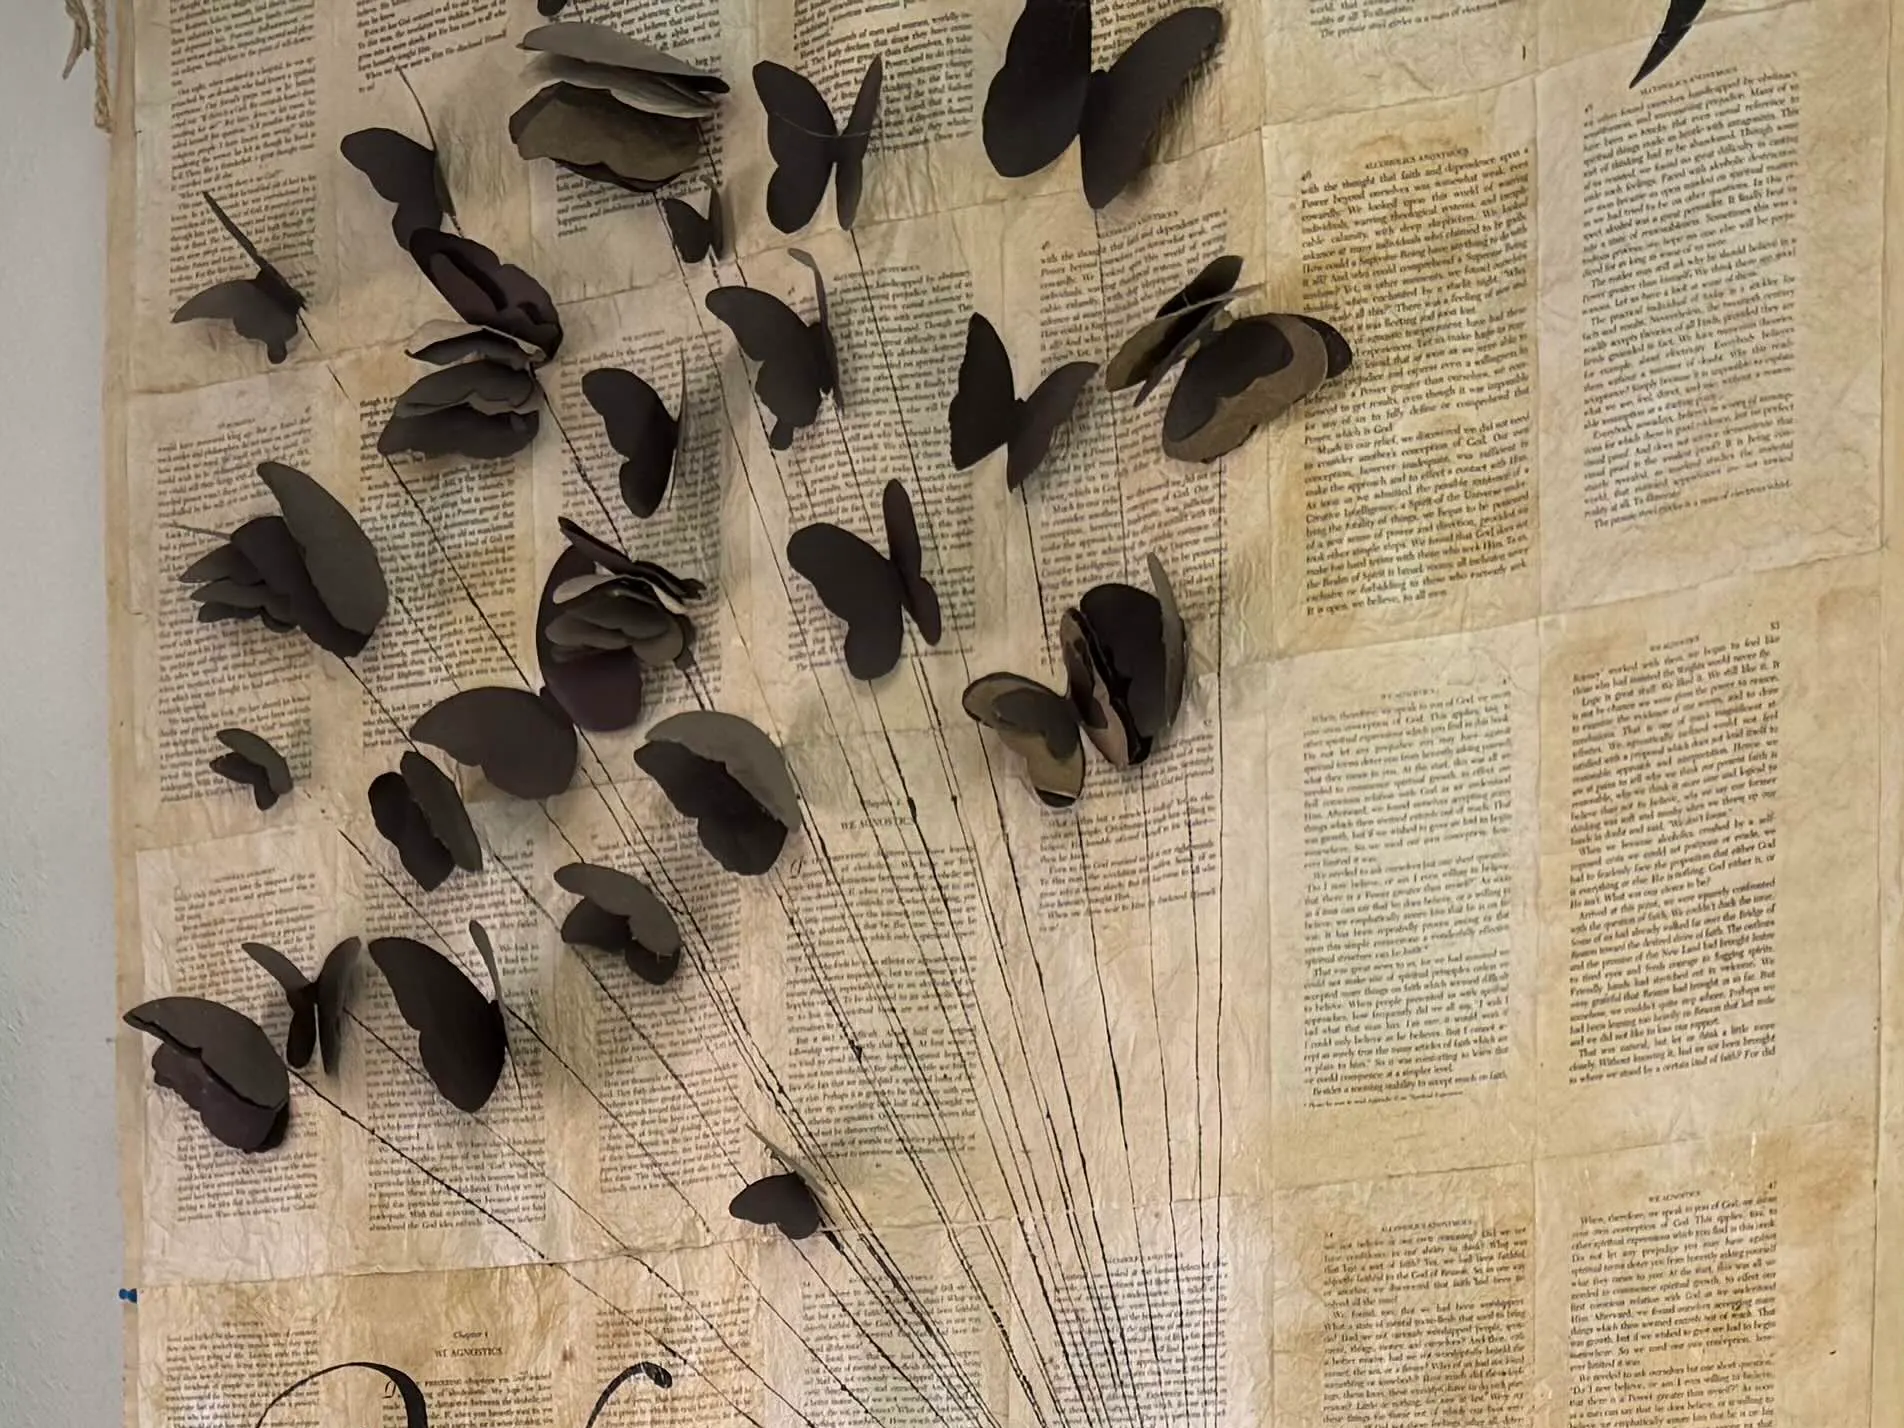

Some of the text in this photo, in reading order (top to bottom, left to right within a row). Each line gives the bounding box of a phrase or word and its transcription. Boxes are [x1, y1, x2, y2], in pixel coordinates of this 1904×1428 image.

[1323, 182, 1338, 193] the
[1379, 172, 1396, 183] that
[1401, 168, 1421, 181] faith
[451, 1347, 503, 1357] AGNOSTICS
